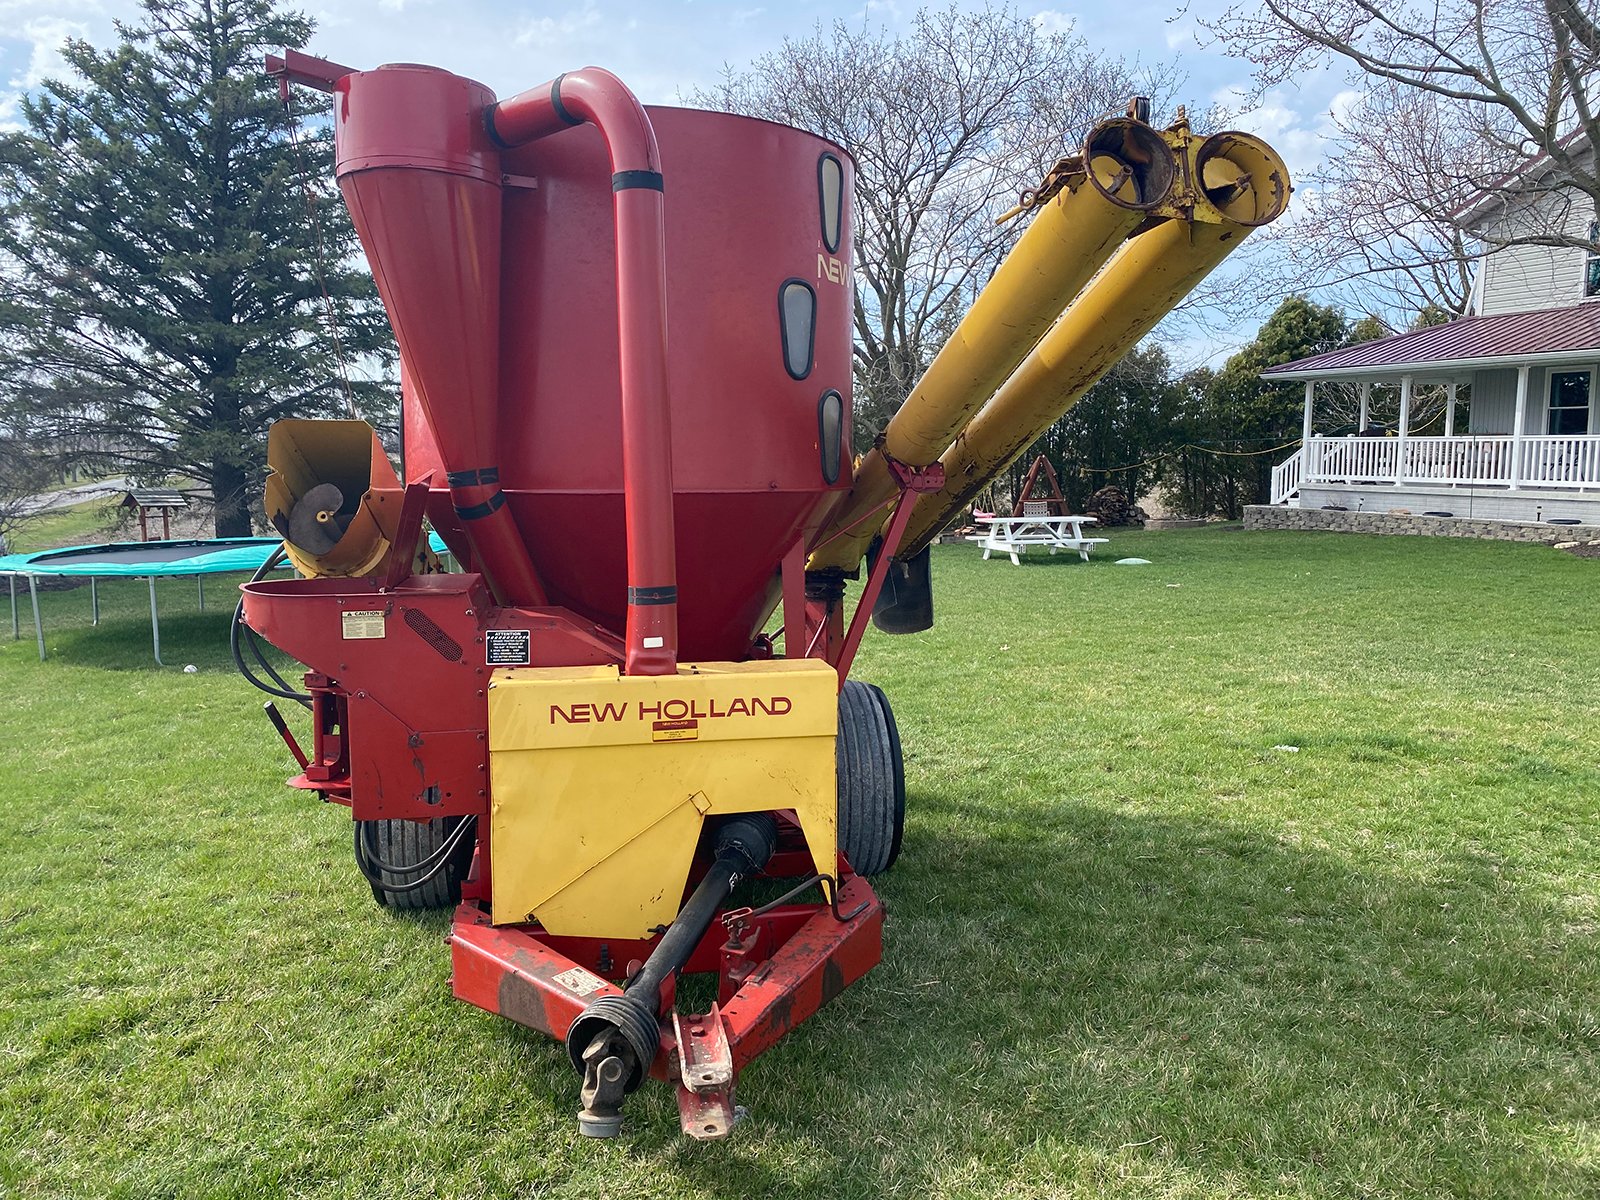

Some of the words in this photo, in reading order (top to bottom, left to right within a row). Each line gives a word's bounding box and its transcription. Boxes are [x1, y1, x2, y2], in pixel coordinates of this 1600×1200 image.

[817, 254, 850, 288] NEW
[550, 702, 628, 724] NEW
[639, 696, 792, 720] HOLLAND
